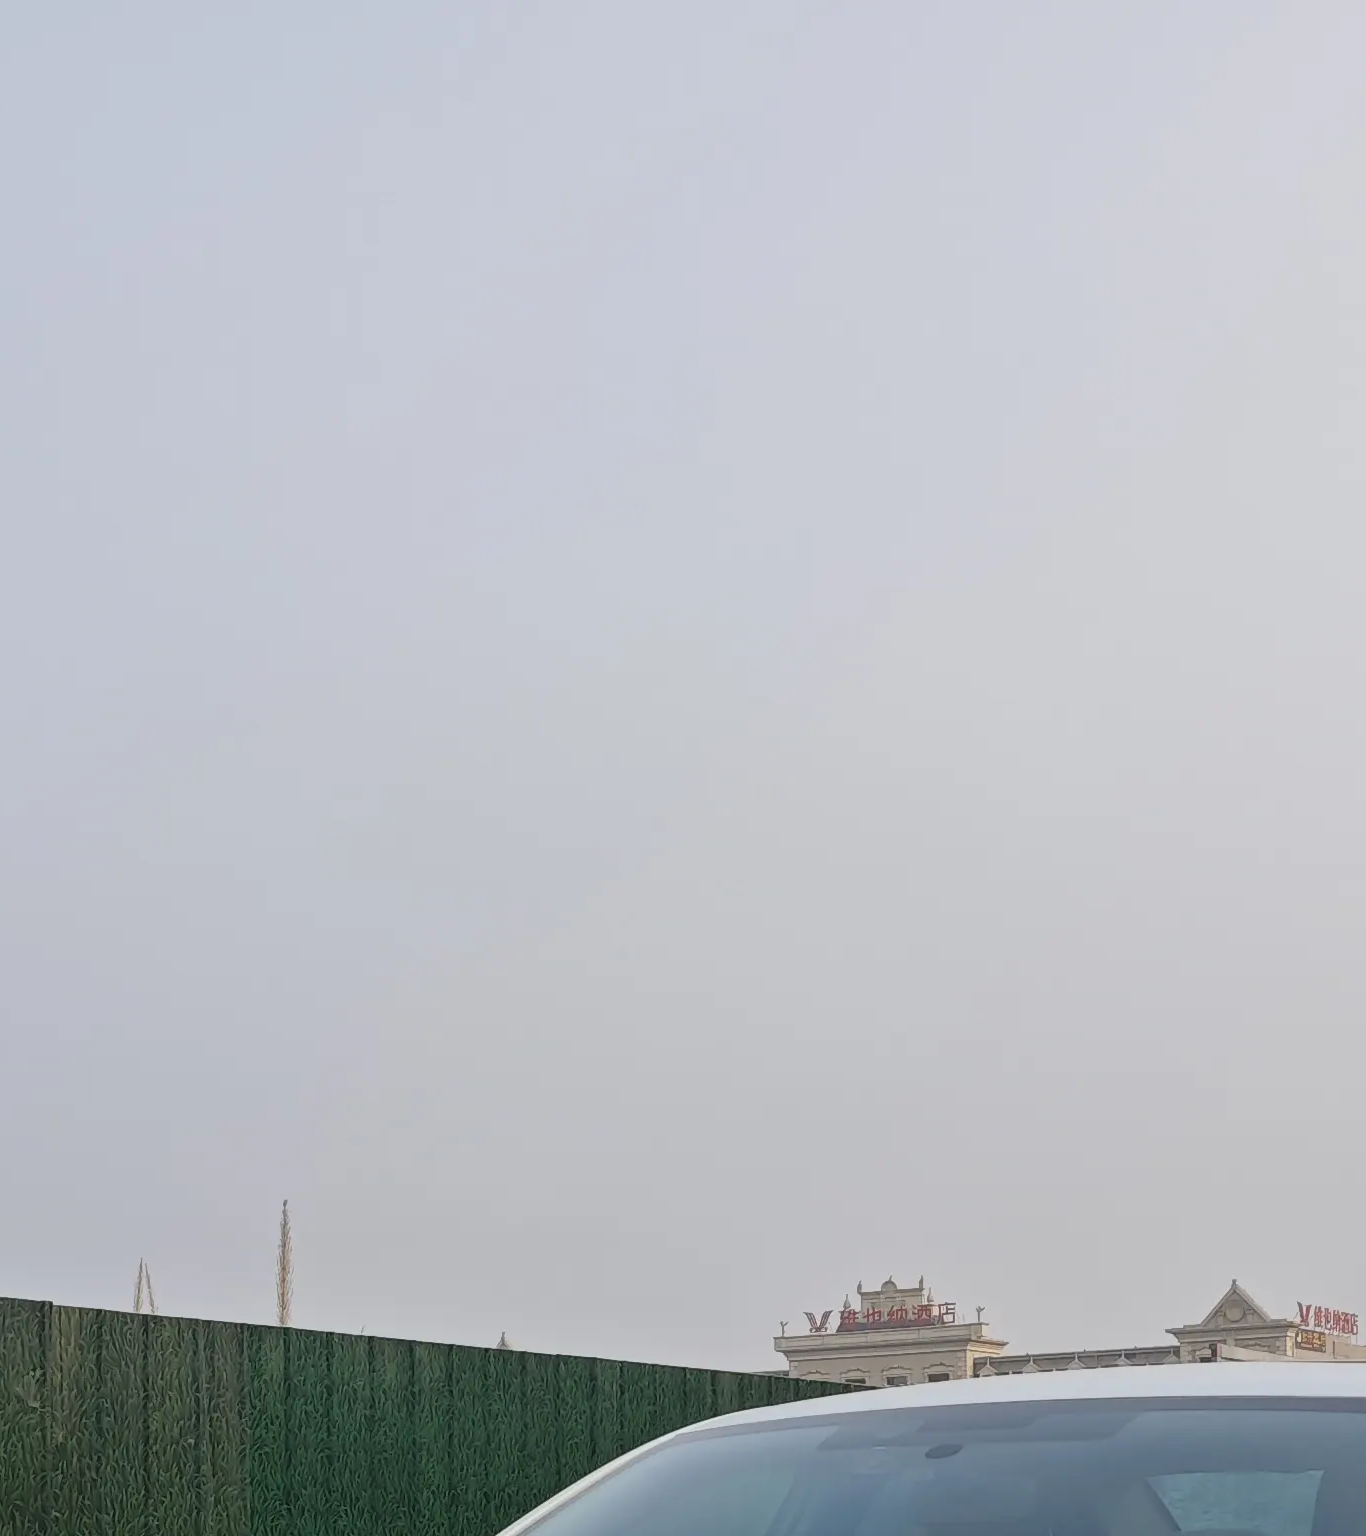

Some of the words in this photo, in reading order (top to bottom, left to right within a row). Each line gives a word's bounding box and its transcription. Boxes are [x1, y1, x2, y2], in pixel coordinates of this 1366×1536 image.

[839, 1302, 957, 1325] 维也纳酒店
[1314, 1305, 1358, 1335] 维也纳酒店
